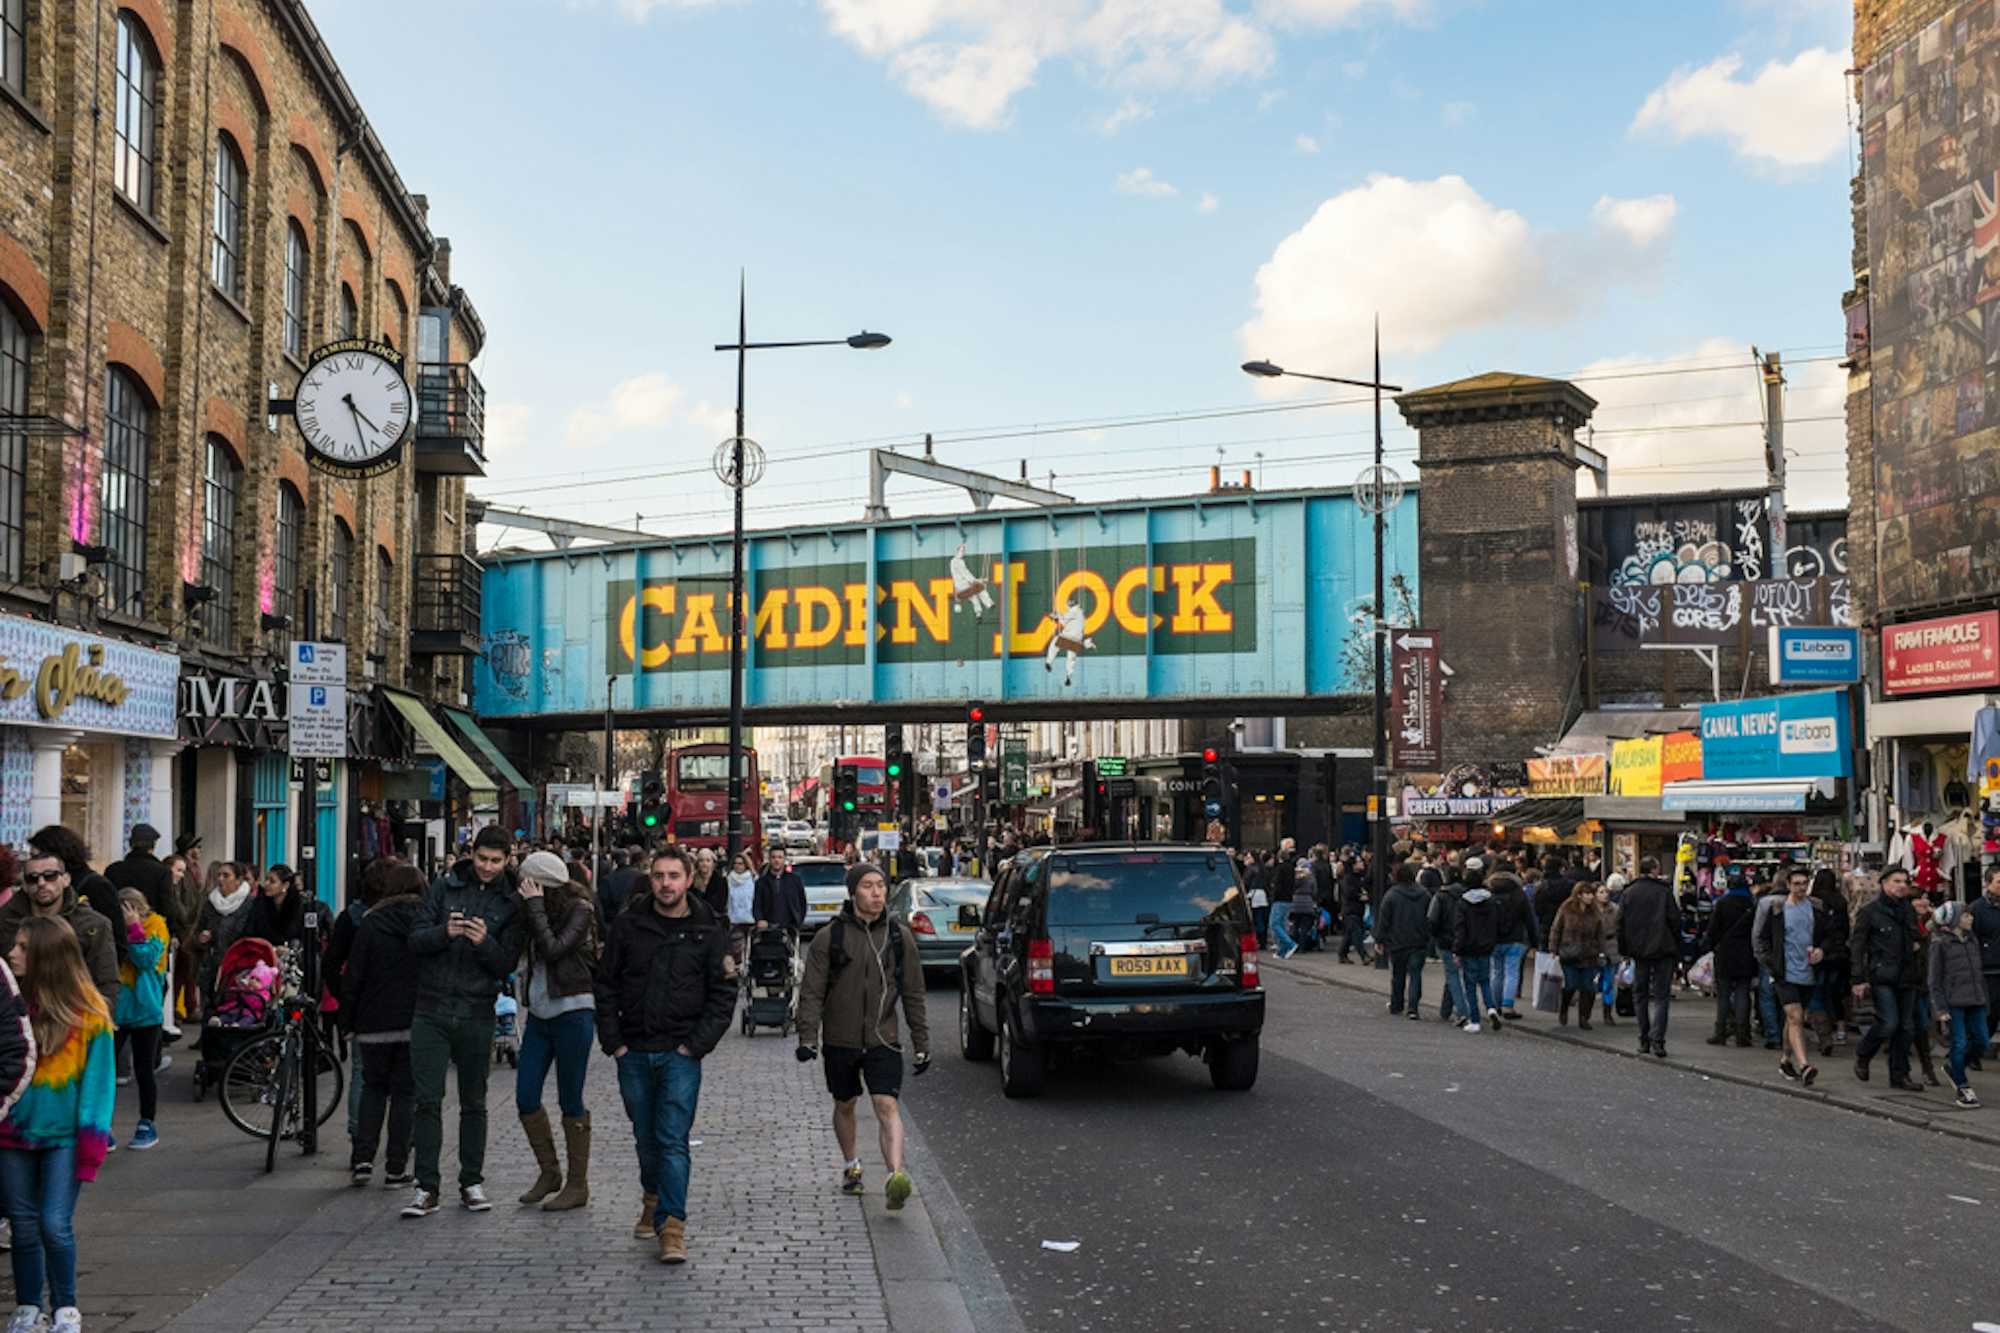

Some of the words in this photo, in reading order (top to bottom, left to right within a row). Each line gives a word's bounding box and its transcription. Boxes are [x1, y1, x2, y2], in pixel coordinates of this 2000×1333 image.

[313, 340, 365, 360] CAMDEN
[368, 342, 401, 364] LOCK
[618, 575, 956, 668] CAMDEN
[992, 559, 1232, 654] LOCK
[1922, 621, 1980, 648] FAMOUS
[1803, 642, 1845, 652] Lebara
[313, 688, 324, 703] P
[1703, 715, 1739, 738] CANAL
[1741, 711, 1777, 736] NEWS
[1794, 722, 1831, 741] Lebara
[1117, 959, 1150, 973] RO59
[1152, 959, 1181, 972] AAX
